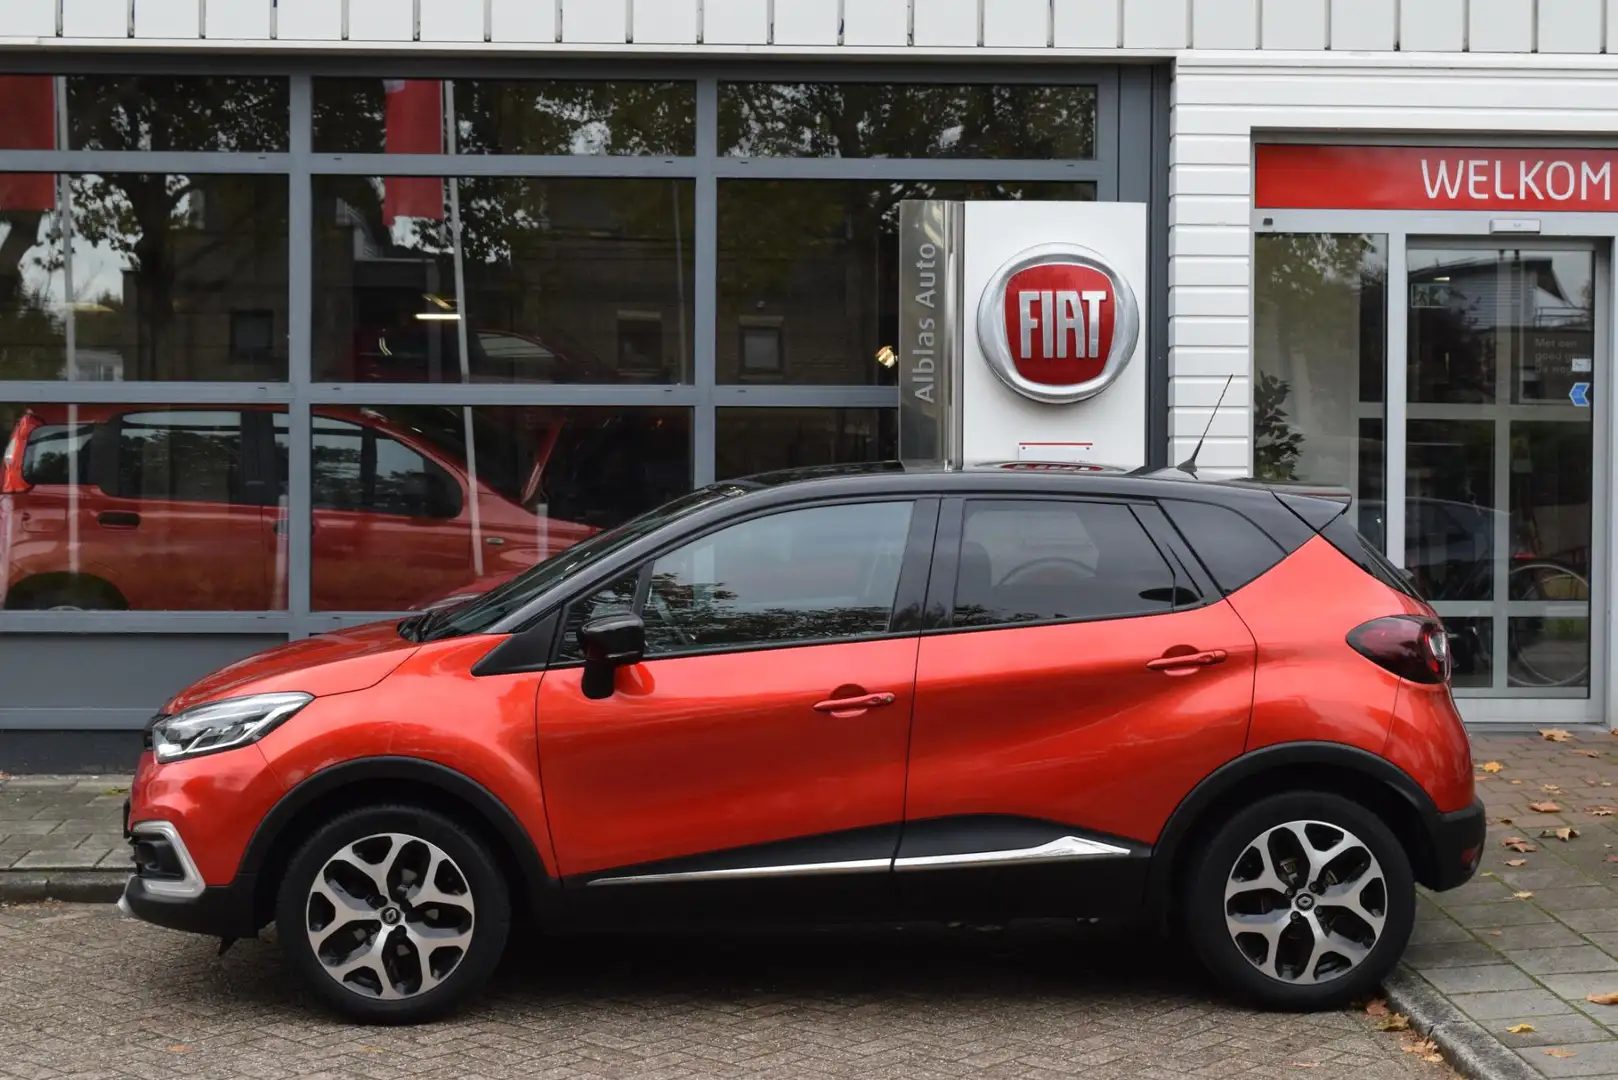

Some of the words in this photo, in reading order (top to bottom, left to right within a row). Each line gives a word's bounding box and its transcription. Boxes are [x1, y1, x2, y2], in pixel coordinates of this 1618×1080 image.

[1421, 159, 1611, 201] WELKOM
[915, 242, 936, 309] Auto
[1018, 291, 1107, 359] FIAT
[912, 318, 936, 403] Alblas
